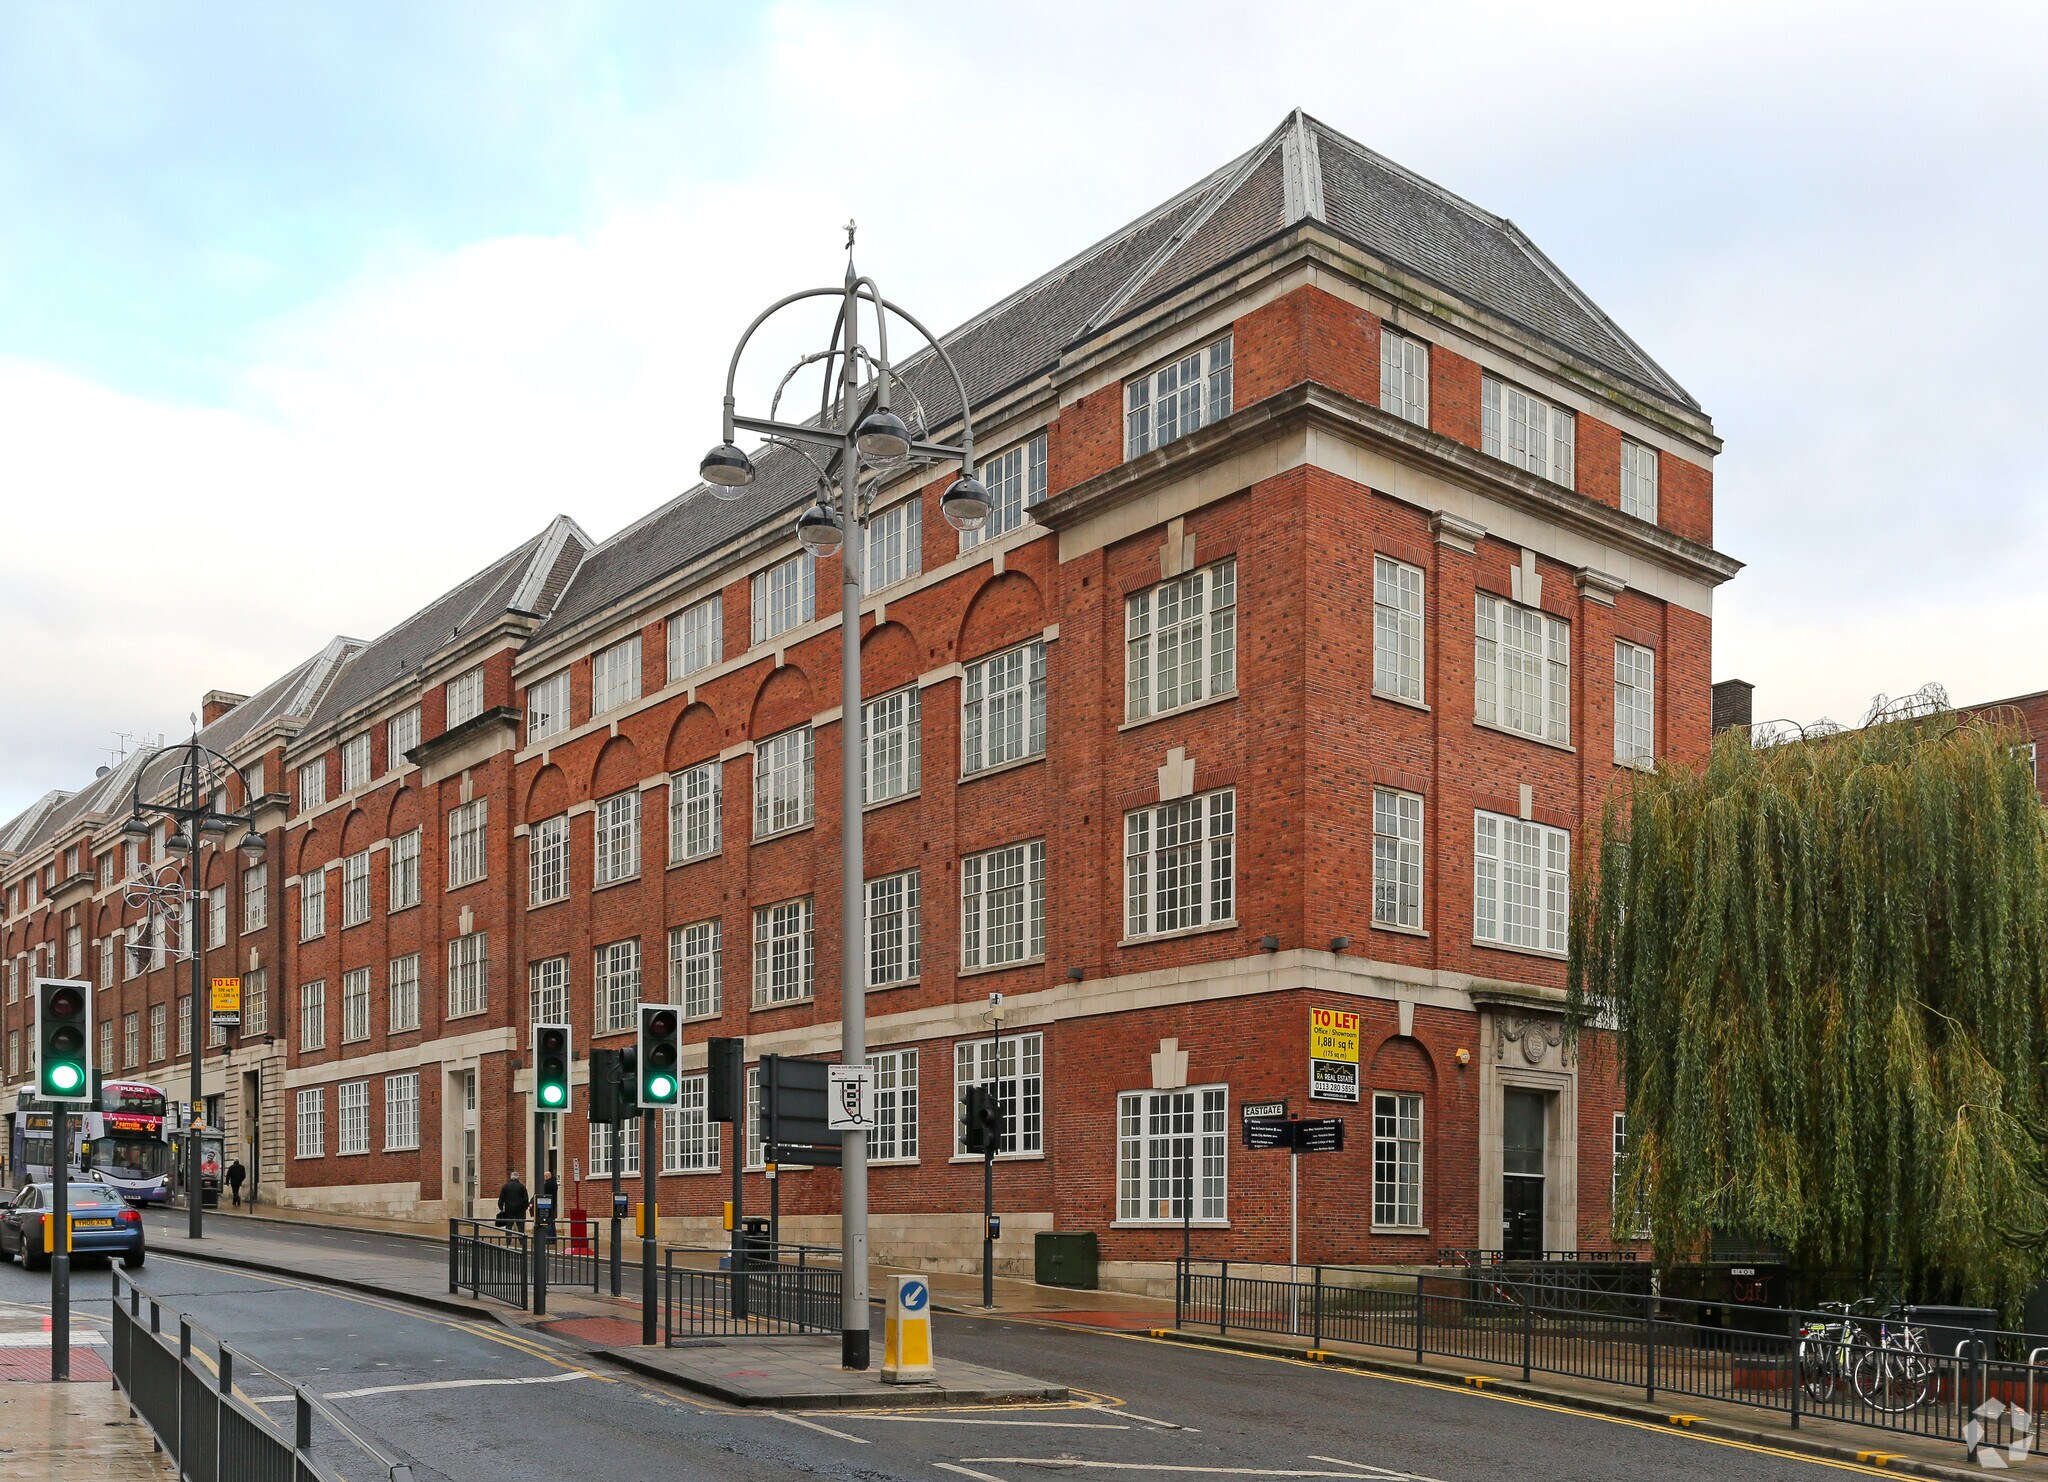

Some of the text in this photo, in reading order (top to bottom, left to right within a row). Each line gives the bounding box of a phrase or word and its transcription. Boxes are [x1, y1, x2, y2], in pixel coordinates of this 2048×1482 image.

[1313, 1010, 1358, 1030] TO LET
[1314, 1026, 1328, 1035] Office
[1332, 1029, 1357, 1038] Showroom
[1317, 1036, 1354, 1051] 1,881 sq ft
[1323, 1050, 1333, 1058] (175
[1324, 1073, 1337, 1081] REAL
[1337, 1074, 1354, 1083] ESTATE
[1315, 1082, 1329, 1090] 0113
[1246, 1105, 1281, 1115] EASTGATE
[146, 1123, 155, 1132] 42
